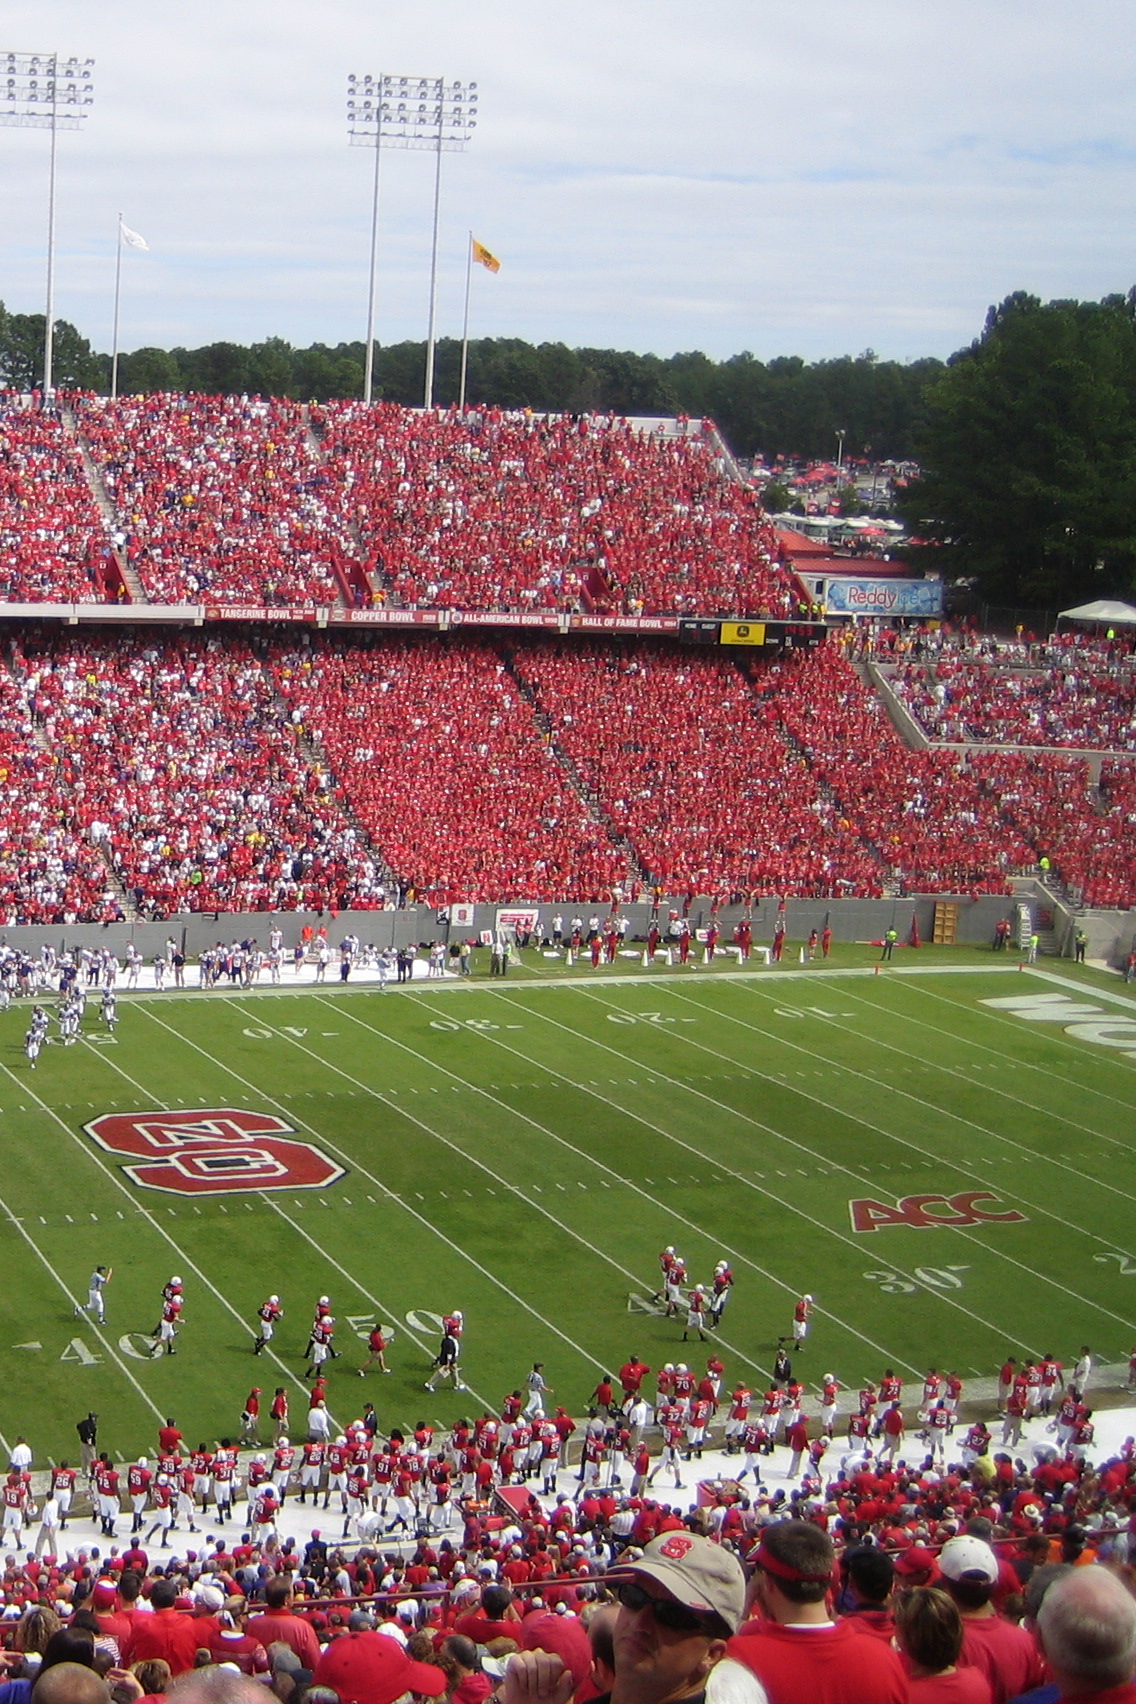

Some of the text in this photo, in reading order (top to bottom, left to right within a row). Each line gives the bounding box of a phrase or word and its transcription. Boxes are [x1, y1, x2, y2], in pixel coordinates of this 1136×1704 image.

[848, 587, 897, 609] Reddy
[219, 608, 266, 619] TANGERINE
[268, 609, 292, 619] BOWL
[351, 610, 386, 621] COPPER
[389, 611, 415, 622] BOWL
[464, 613, 520, 624] ALL-AMERICAN
[522, 615, 544, 625] BOWL
[582, 617, 603, 626] HALL
[604, 617, 614, 626] OF
[616, 618, 638, 627] FAME
[640, 619, 662, 628] BOWL
[848, 1191, 1031, 1233] ACC
[862, 1266, 962, 1293] 30
[60, 1332, 164, 1366] 40
[676, 1380, 689, 1390] 70
[853, 1421, 859, 1432] 9
[162, 1462, 174, 1473] 39
[378, 1462, 389, 1473] 91
[130, 1473, 141, 1485] 59
[6, 1492, 17, 1504] 19
